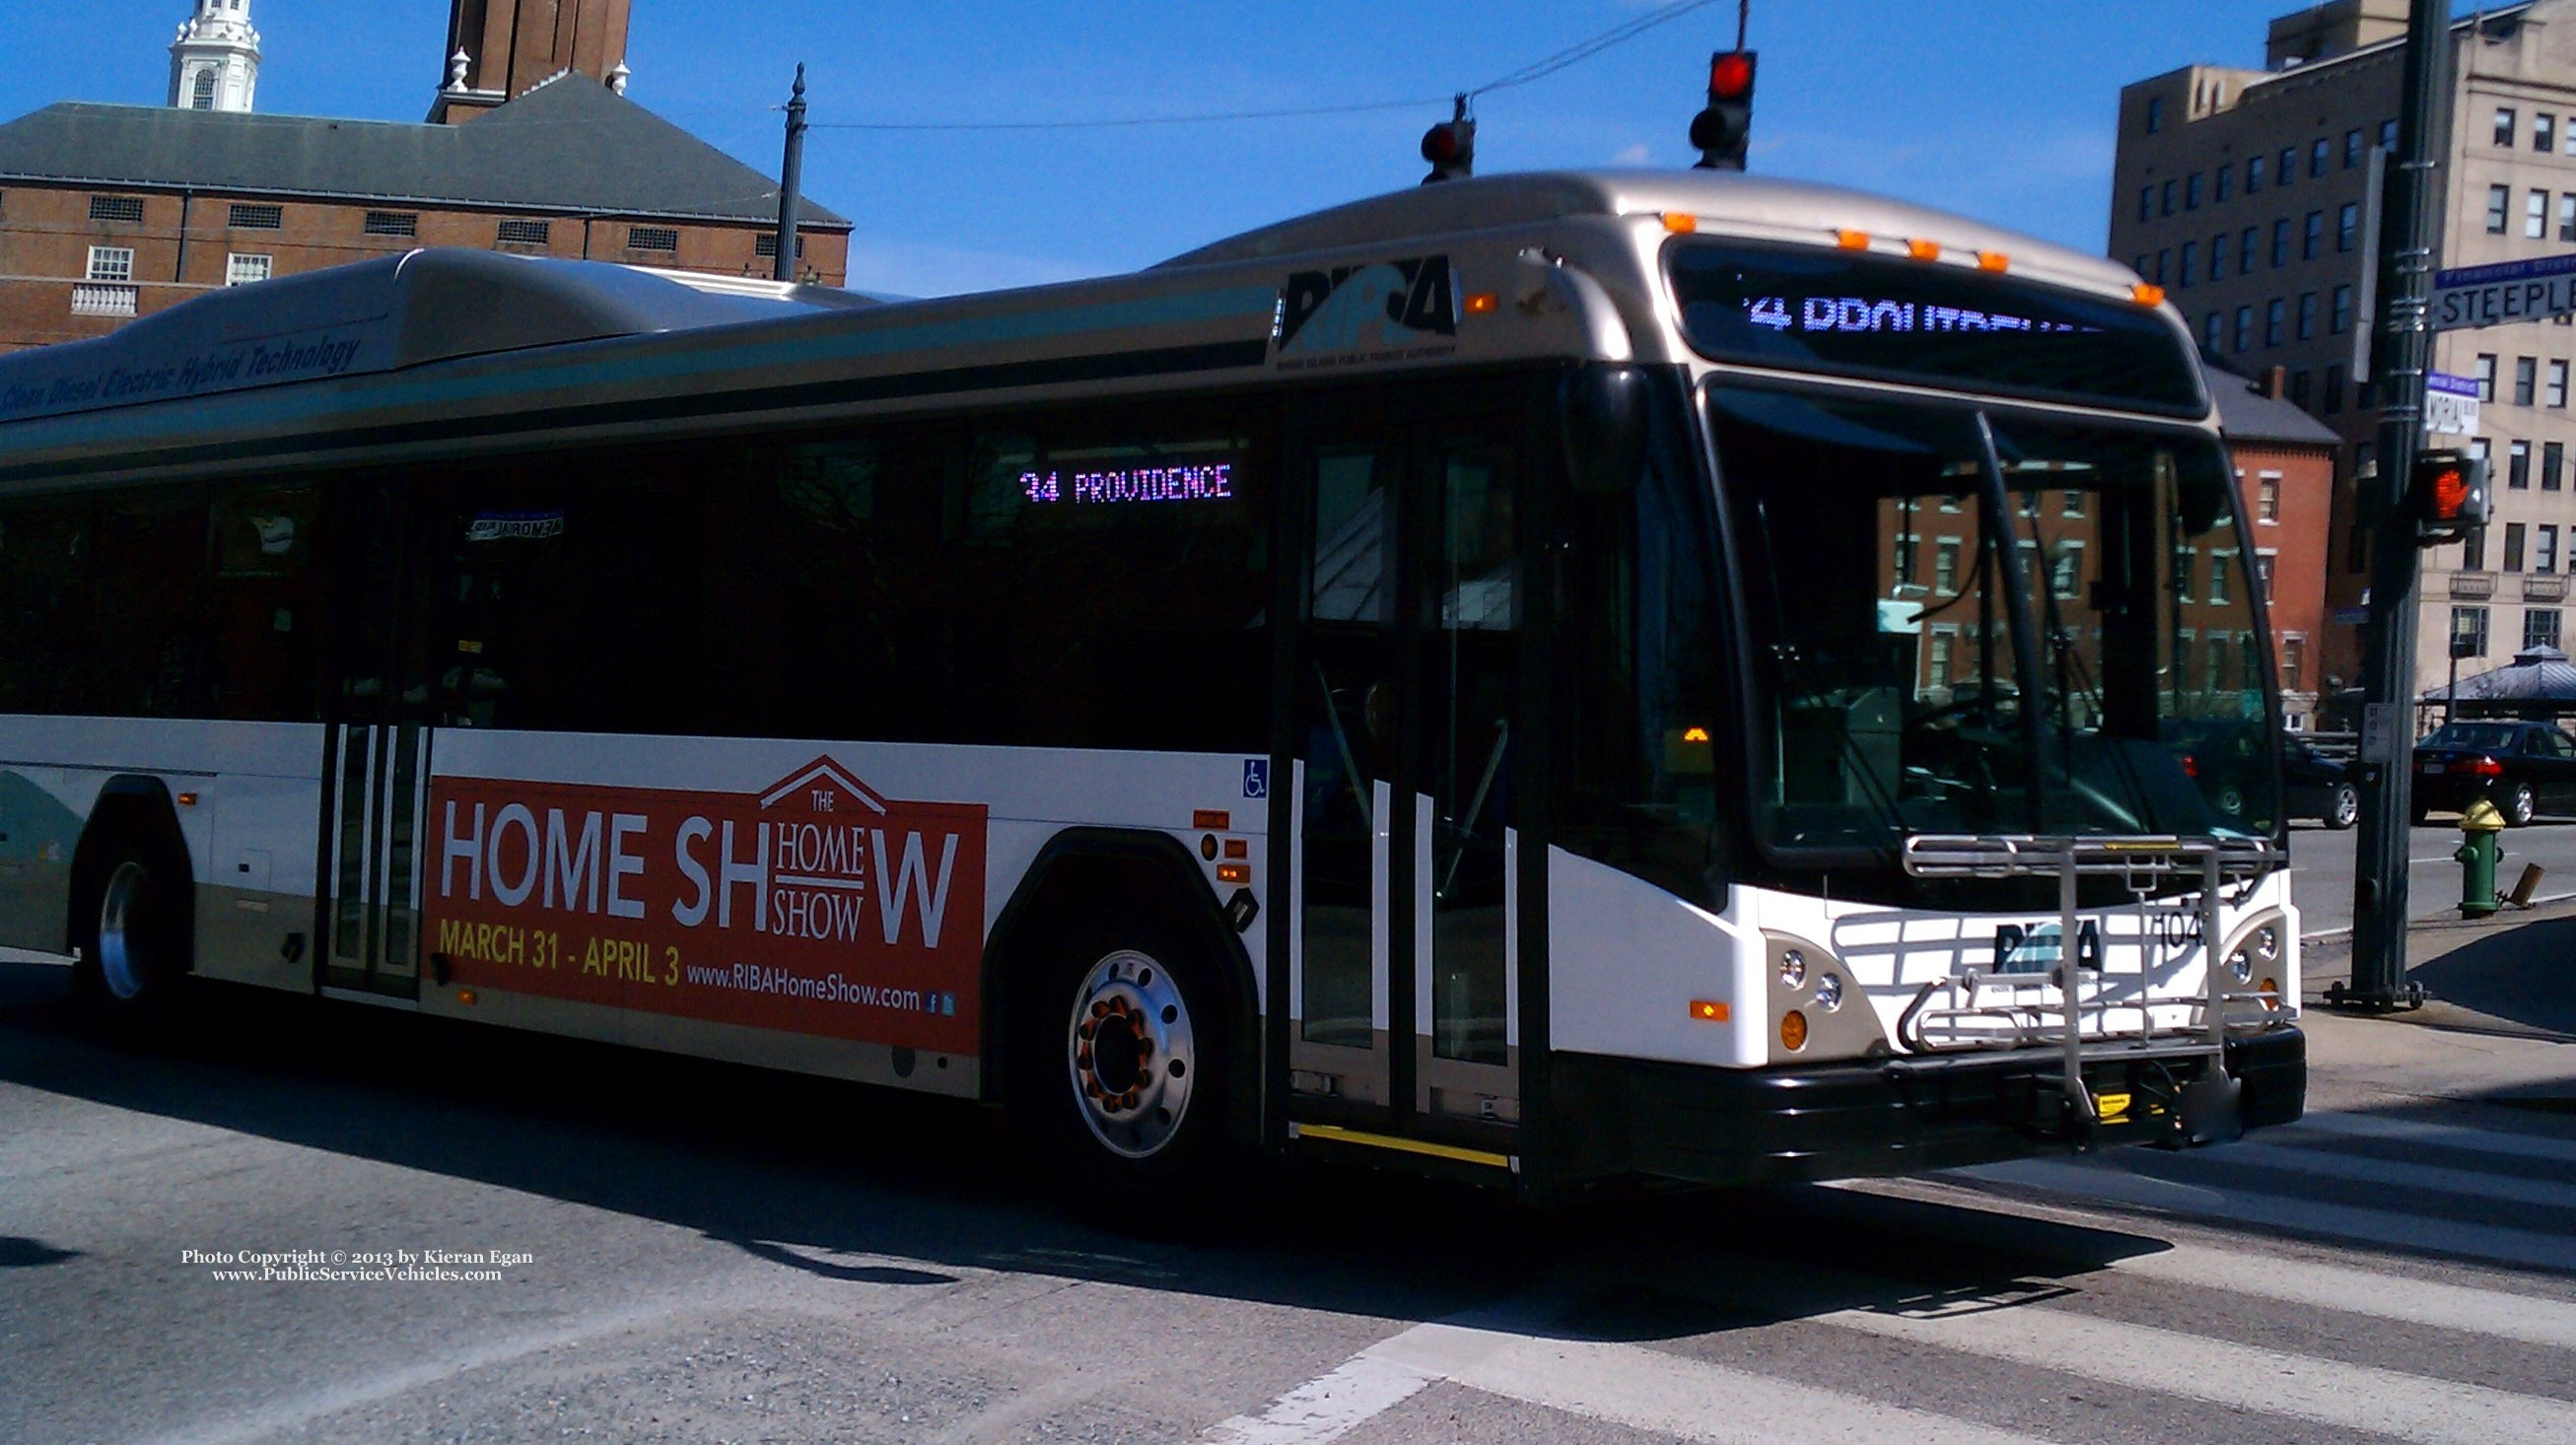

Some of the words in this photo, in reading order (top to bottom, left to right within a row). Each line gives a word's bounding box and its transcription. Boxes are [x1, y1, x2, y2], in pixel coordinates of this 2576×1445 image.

[104, 362, 175, 398] Electric
[176, 351, 244, 392] Hybrid
[246, 334, 361, 378] Technology
[1076, 463, 1231, 503] PROVIDENCE
[811, 790, 834, 812] THE
[442, 800, 648, 920] HOME
[776, 822, 865, 875] HOME
[773, 889, 864, 942] SHOW
[439, 918, 524, 964] MARCH
[532, 929, 557, 969] 31
[583, 936, 656, 984] APRIL
[664, 946, 679, 986] 3
[687, 963, 920, 1011] www.RIBAHomeShow.com
